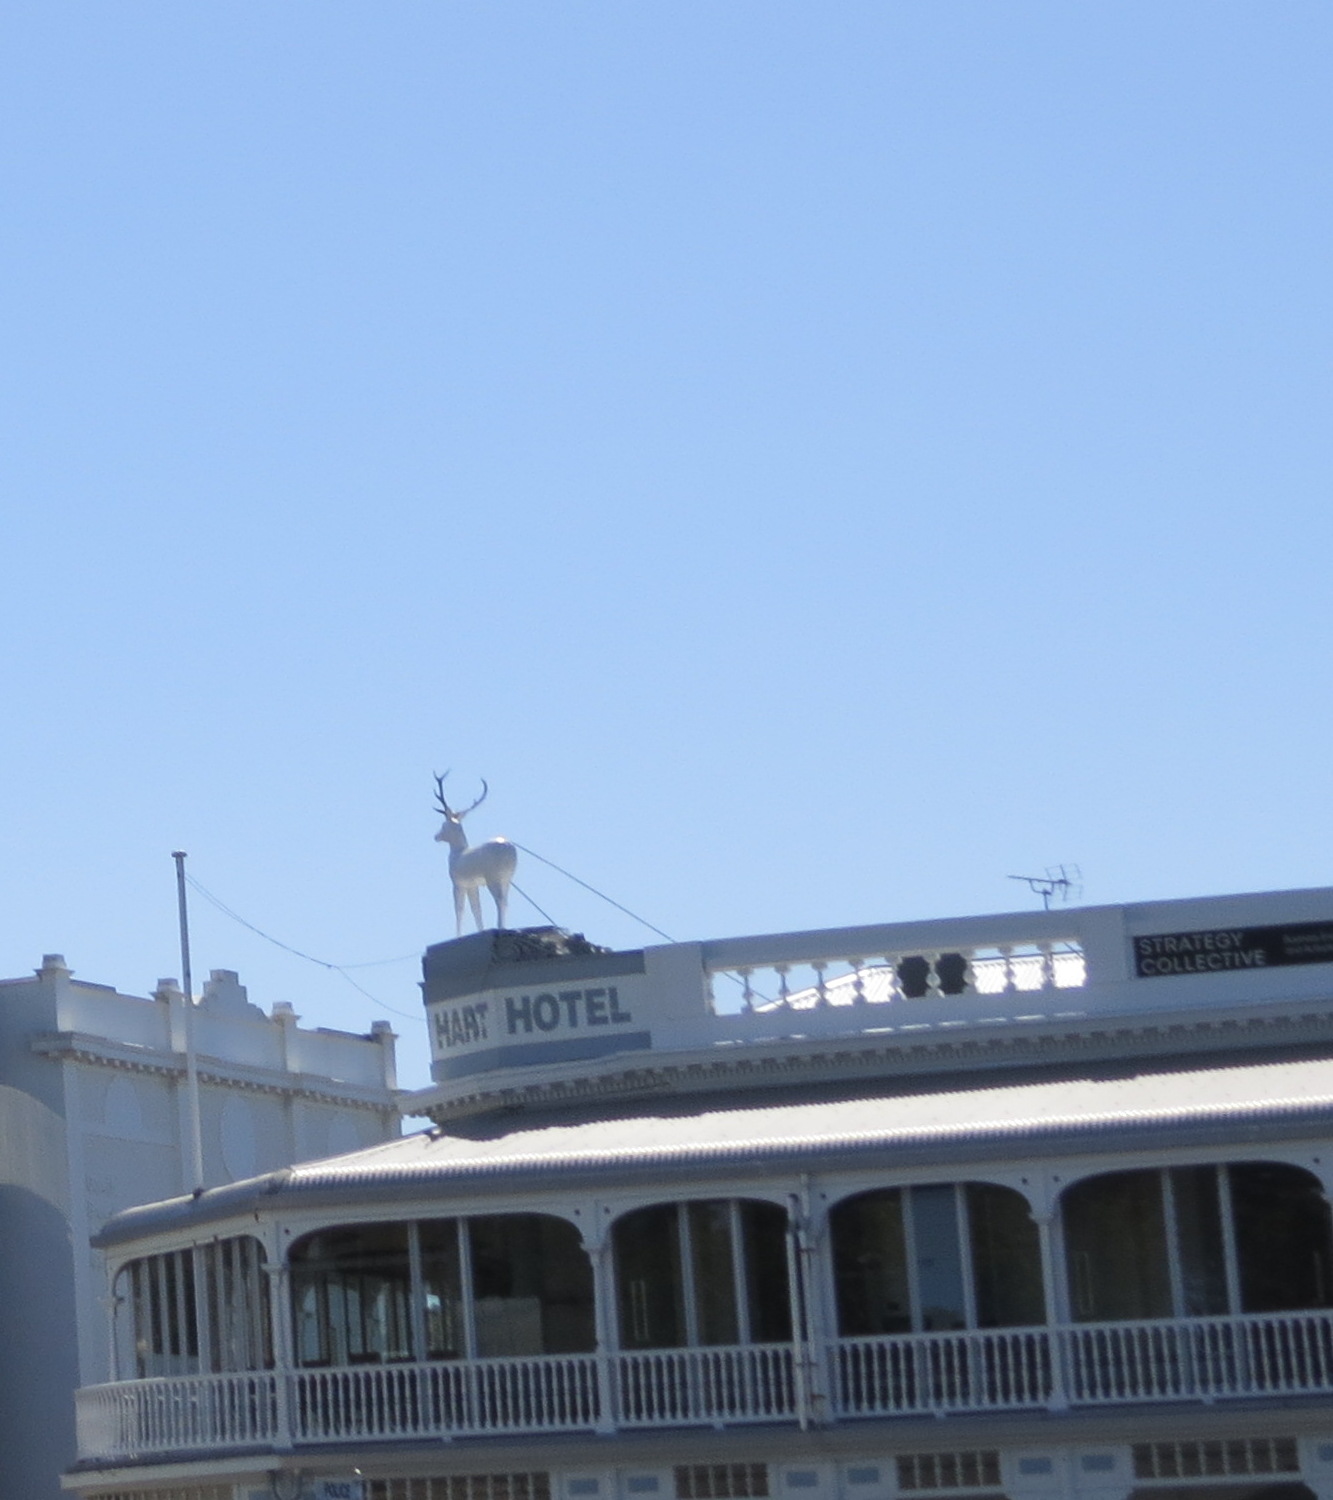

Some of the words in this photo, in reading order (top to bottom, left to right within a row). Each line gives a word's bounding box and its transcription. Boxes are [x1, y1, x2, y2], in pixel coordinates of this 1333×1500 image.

[1139, 932, 1244, 955] STRATEGY
[1140, 948, 1268, 975] COLLECTIVE
[435, 1004, 489, 1049] HART
[504, 988, 632, 1034] HOTEL
